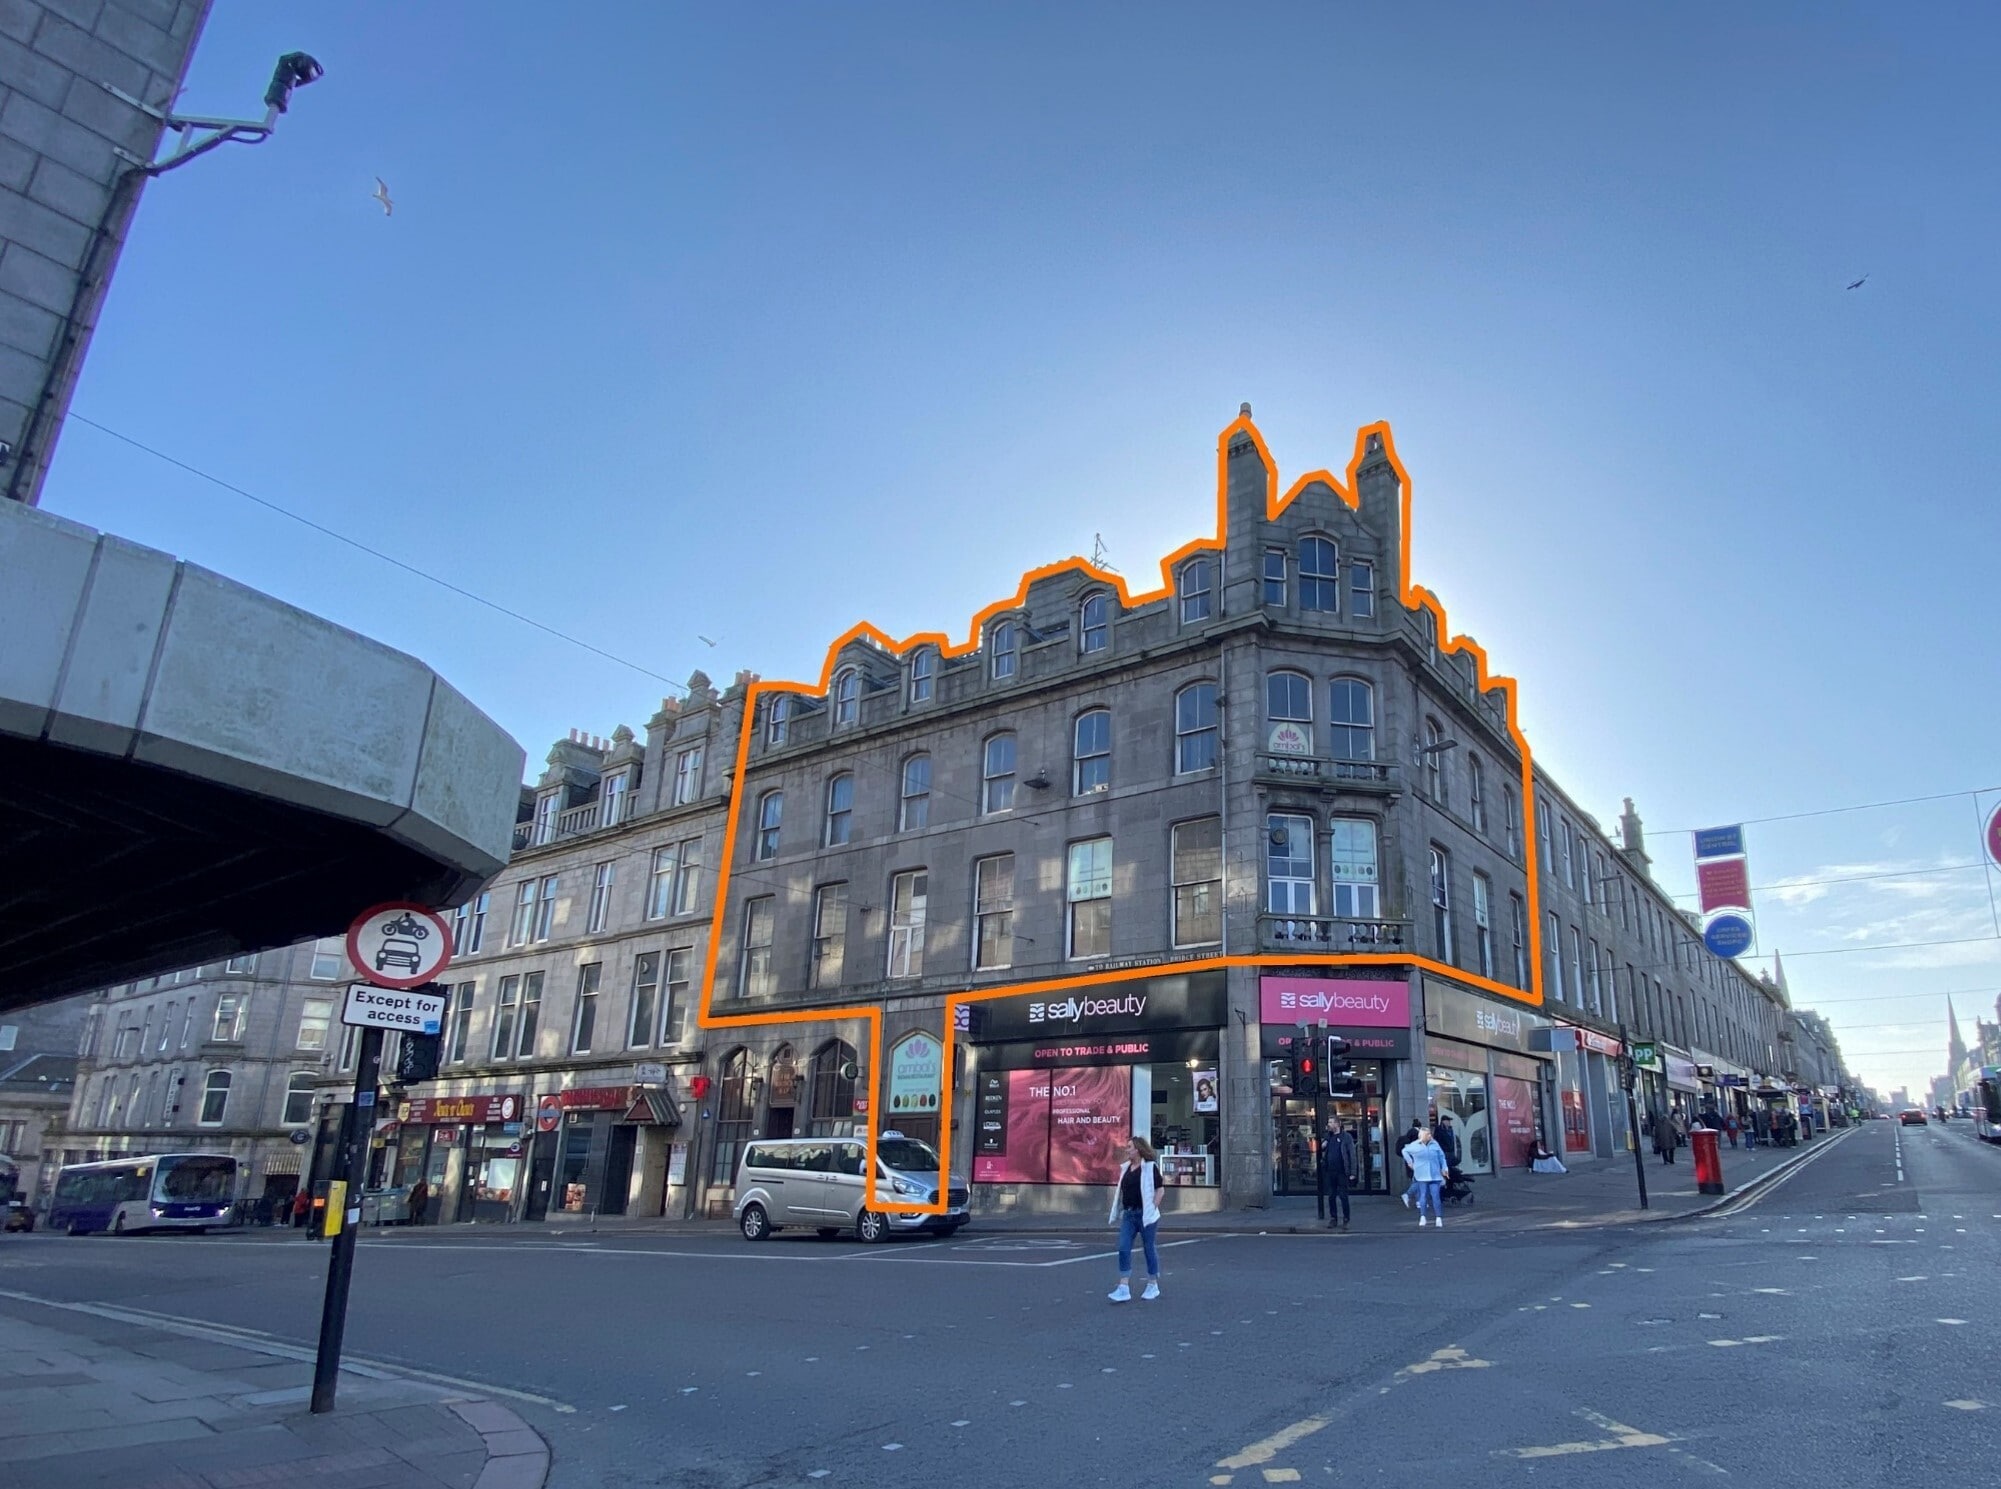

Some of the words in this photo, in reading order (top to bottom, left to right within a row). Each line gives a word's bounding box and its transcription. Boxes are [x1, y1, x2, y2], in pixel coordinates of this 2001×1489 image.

[1105, 961, 1132, 970] RAILWAY
[1134, 958, 1161, 967] STATION
[355, 990, 412, 1009] Except
[416, 999, 438, 1013] for
[367, 1009, 421, 1025] access
[1362, 1039, 1395, 1047] PUBLIC
[1034, 1048, 1059, 1058] OPEN
[1060, 1047, 1073, 1057] TO
[1074, 1045, 1105, 1056] TRADE
[1106, 1044, 1113, 1054] &
[1115, 1043, 1149, 1054] PUBLIC
[1028, 1086, 1050, 1098] THE
[1053, 1085, 1076, 1097] NO.1
[1052, 1107, 1090, 1115] PROFESSIONAL
[1057, 1117, 1075, 1125] HAIR
[1076, 1116, 1091, 1124] AND
[1092, 1115, 1121, 1124] BEAUTY
